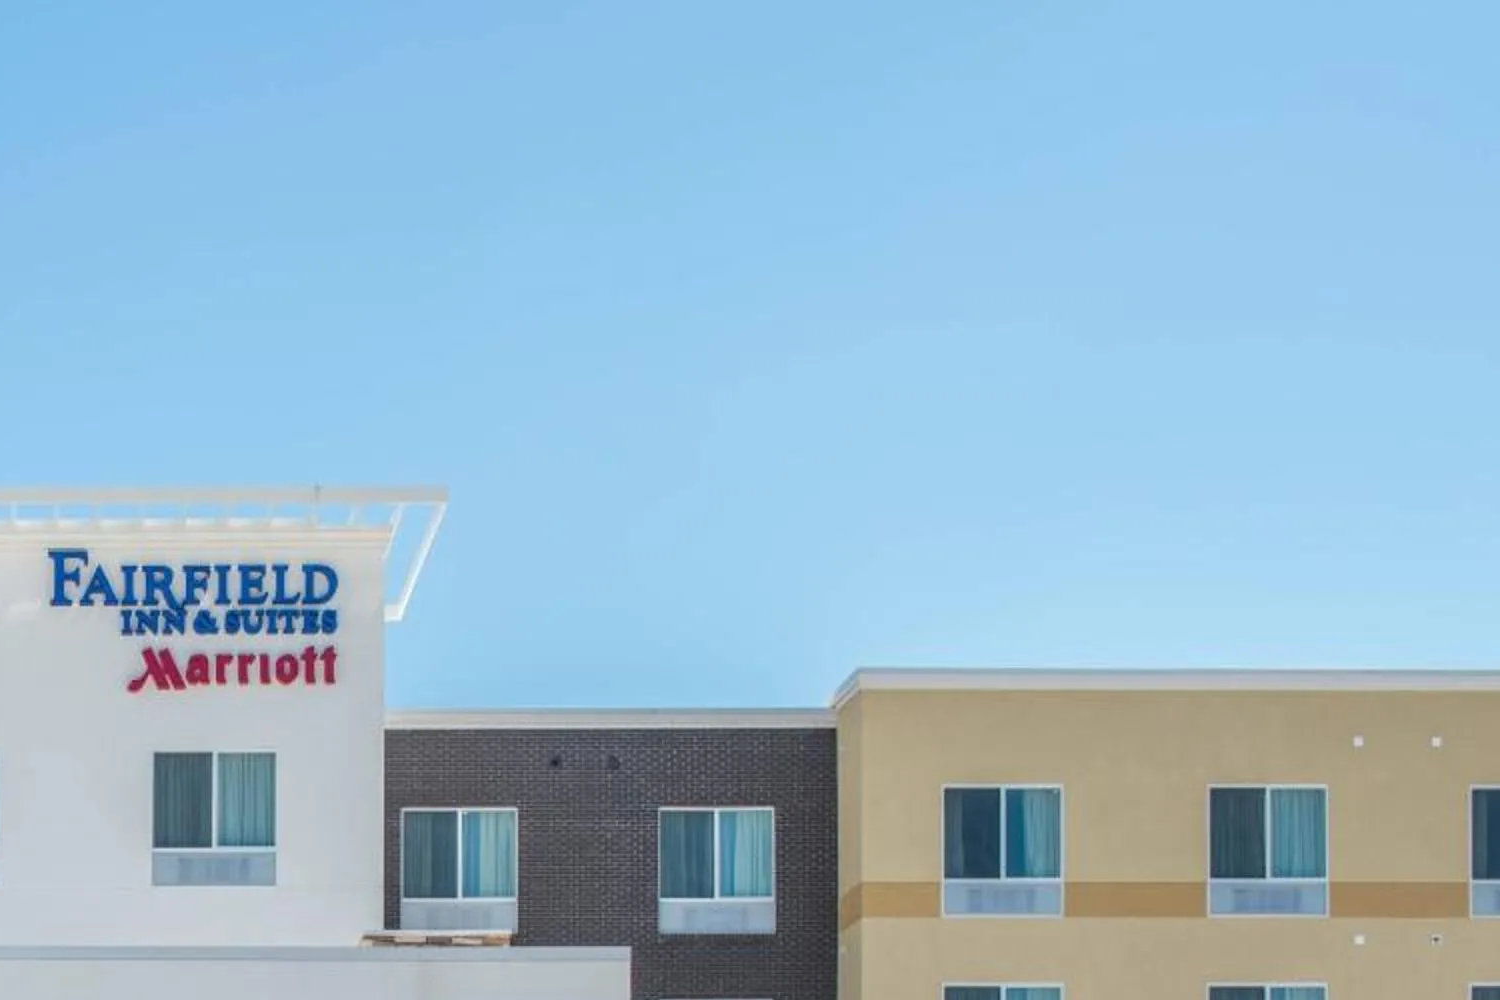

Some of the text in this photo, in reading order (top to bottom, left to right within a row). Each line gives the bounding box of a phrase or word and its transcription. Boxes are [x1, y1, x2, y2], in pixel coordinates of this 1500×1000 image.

[48, 548, 339, 608] FAIRFIELD
[120, 609, 339, 636] INN & SUITES
[127, 645, 338, 694] Marriott
